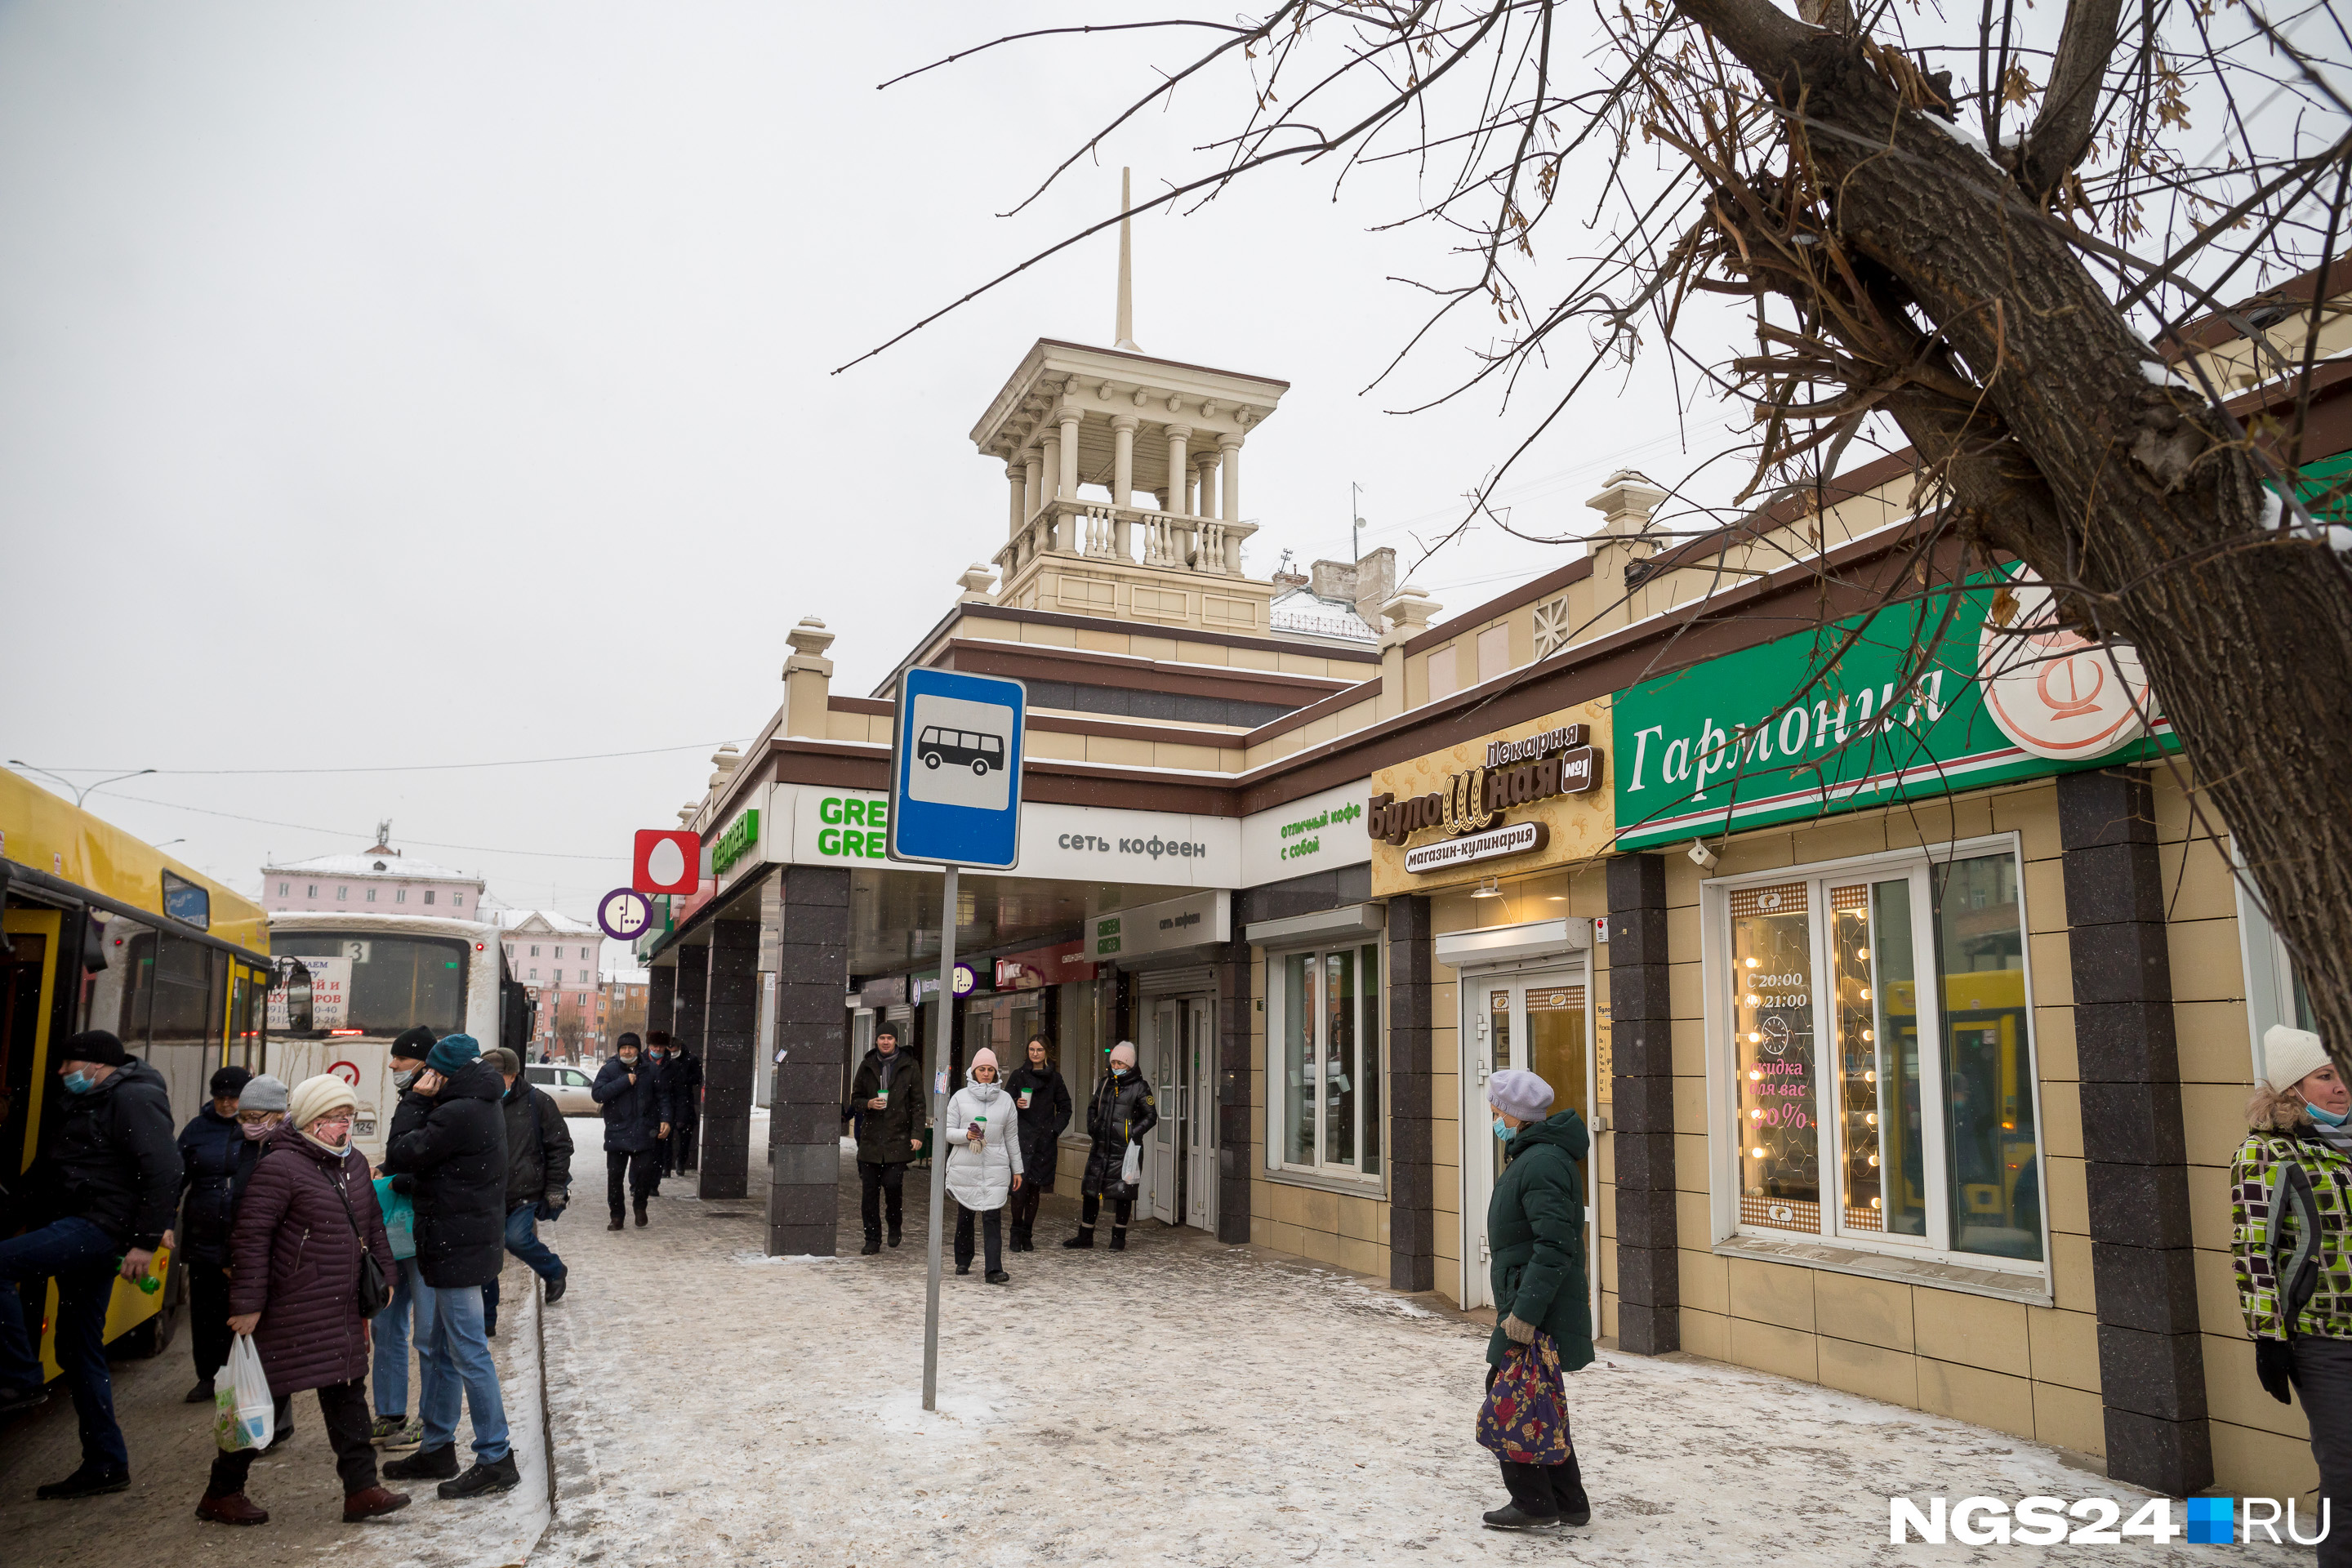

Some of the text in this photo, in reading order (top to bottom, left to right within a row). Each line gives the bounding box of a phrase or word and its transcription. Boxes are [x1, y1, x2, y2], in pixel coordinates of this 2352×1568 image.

[1486, 724, 1580, 768] Пекарня
[1626, 669, 1947, 803] Гармония
[820, 797, 888, 827] GRE
[1281, 802, 1361, 839] отличный кофе
[817, 828, 887, 859] GRE
[1058, 834, 1205, 860] сеть кофеен
[1281, 835, 1320, 860] с собой
[1407, 826, 1534, 867] магазин-кулинария
[350, 942, 363, 962] 3
[1759, 973, 1802, 988] 20:00
[1764, 994, 1807, 1009] 21:00
[1750, 1058, 1803, 1076] скидка
[1749, 1080, 1806, 1097] для вас
[1750, 1102, 1806, 1130] 30%
